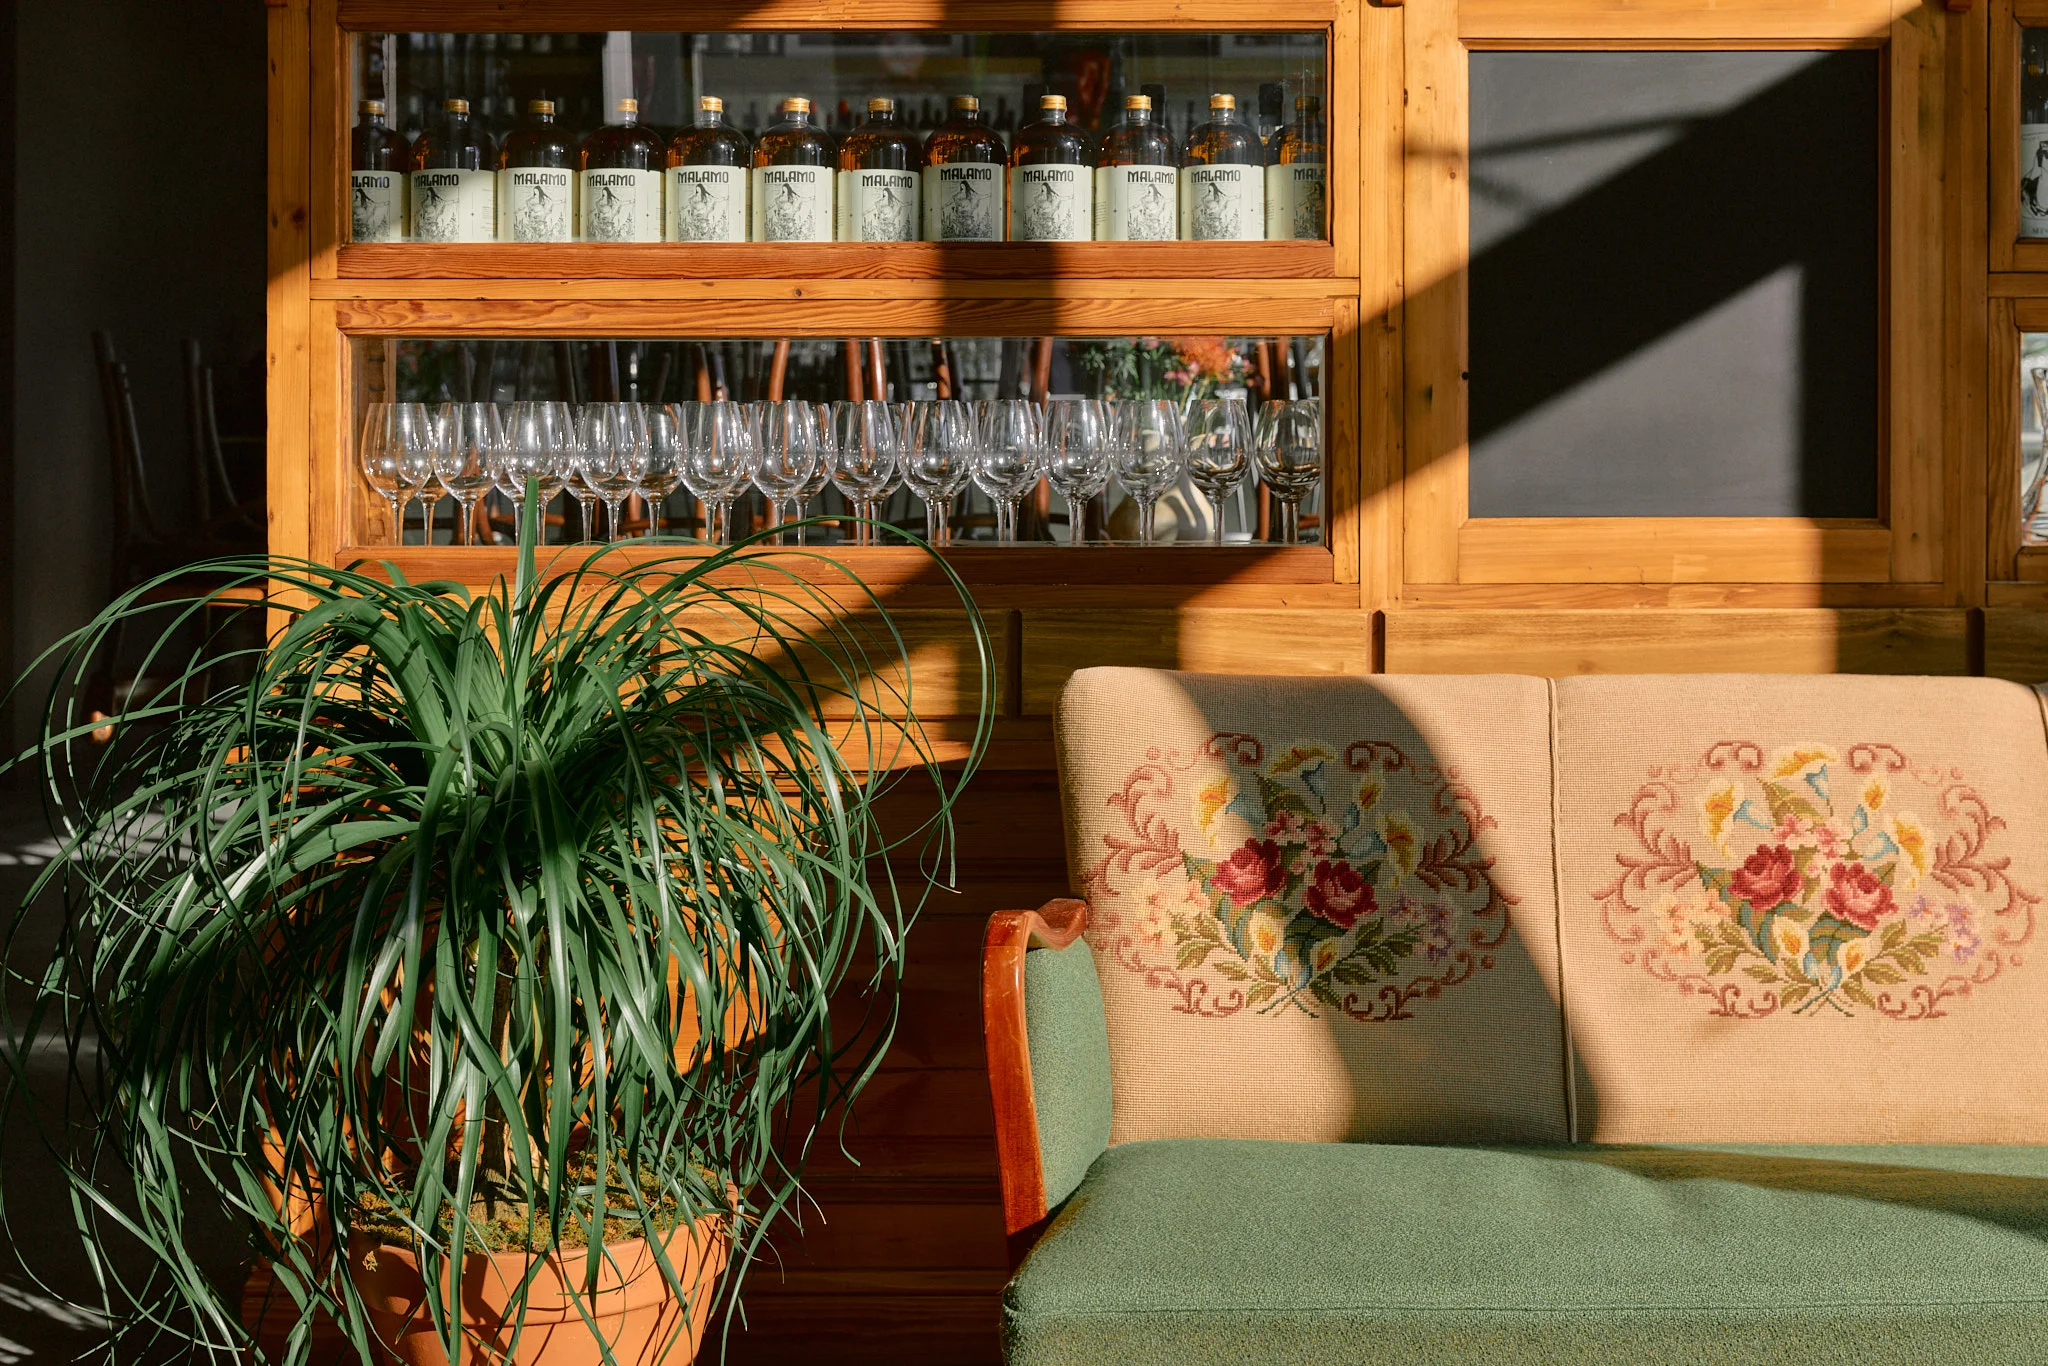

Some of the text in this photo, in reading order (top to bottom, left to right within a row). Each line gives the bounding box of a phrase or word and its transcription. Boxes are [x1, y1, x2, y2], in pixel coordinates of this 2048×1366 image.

[414, 174, 459, 187] MALAMO
[514, 173, 567, 186] MALAMO
[587, 174, 636, 187] MALAMO
[678, 171, 729, 184] MALAMO
[764, 171, 816, 183] MALAMO
[941, 168, 992, 181] MALAMO
[1023, 170, 1074, 182] MALAMO
[1128, 171, 1175, 184] MALAMO
[1191, 170, 1241, 182] MALAMO
[1294, 168, 1326, 181] MALA
[352, 175, 390, 188] LAMO
[862, 175, 913, 188] MALAMO
